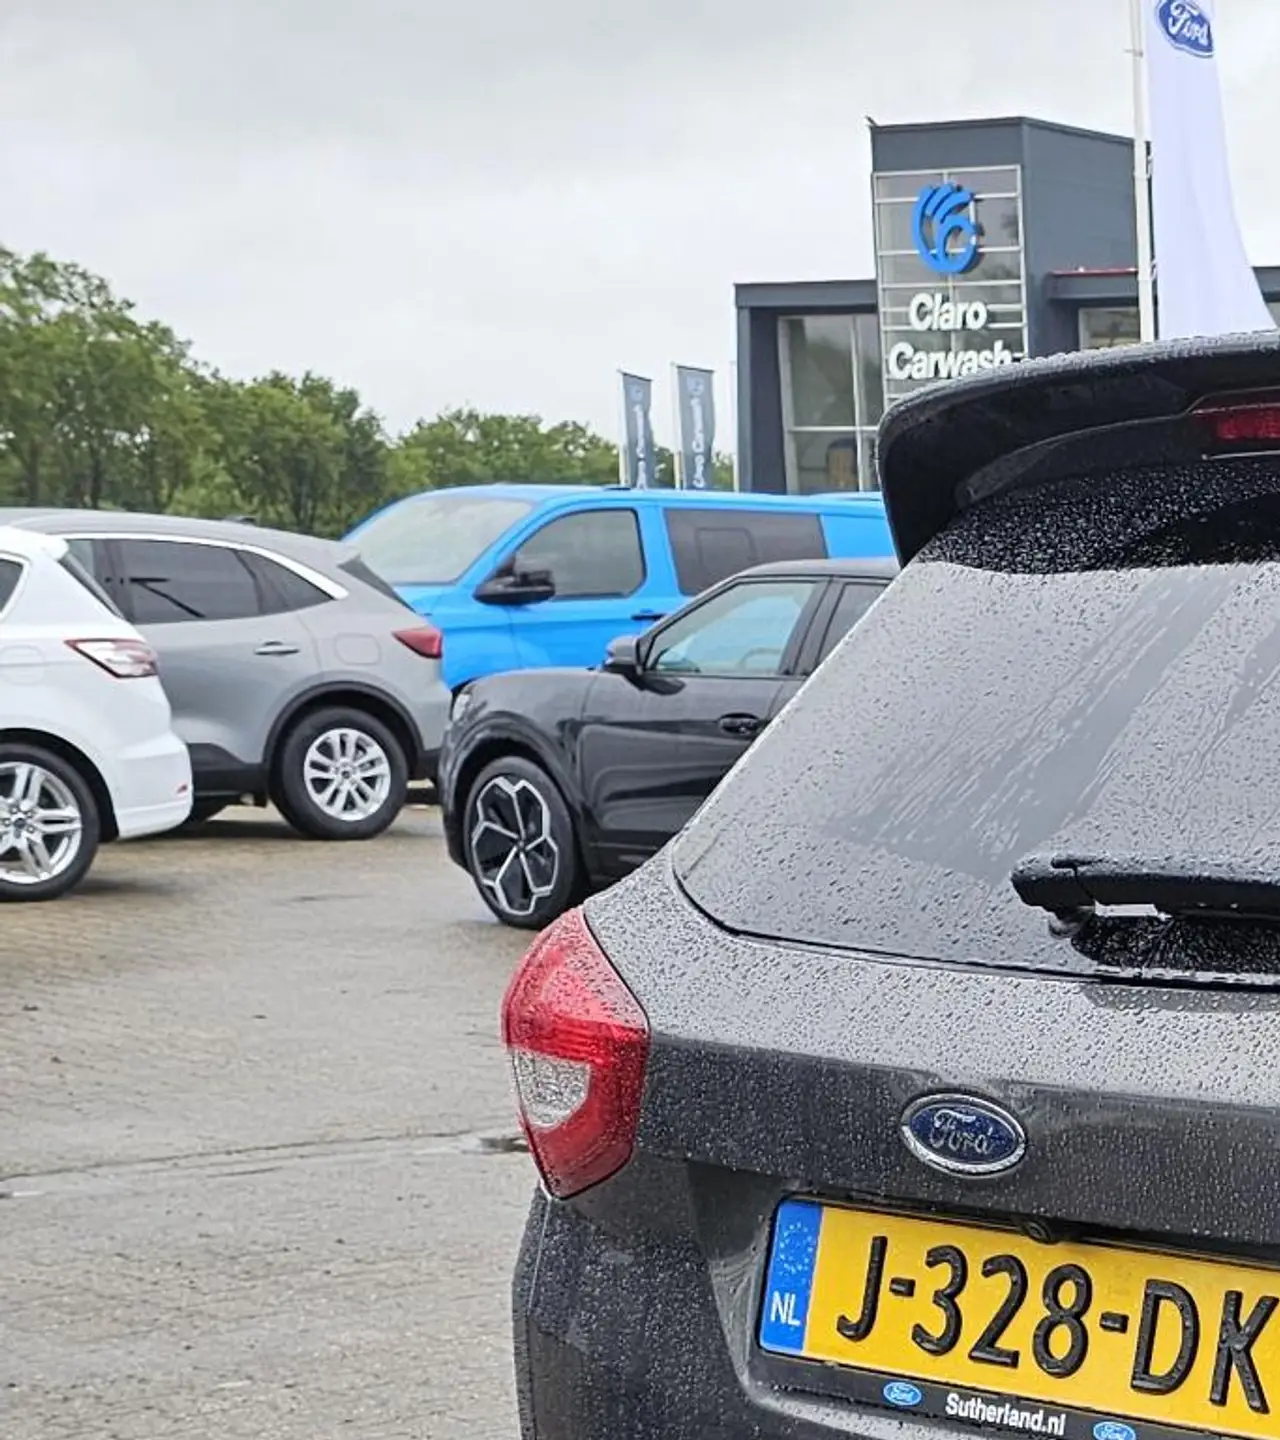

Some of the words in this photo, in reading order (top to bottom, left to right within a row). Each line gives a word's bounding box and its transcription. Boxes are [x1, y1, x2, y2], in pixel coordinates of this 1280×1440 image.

[1167, 0, 1209, 46] Ford
[909, 292, 987, 331] Claro
[888, 340, 1013, 380] Carwash
[770, 1290, 801, 1327] NL
[836, 1235, 1280, 1415] J-328-DK
[944, 1391, 1067, 1436] Sutherland.nl
